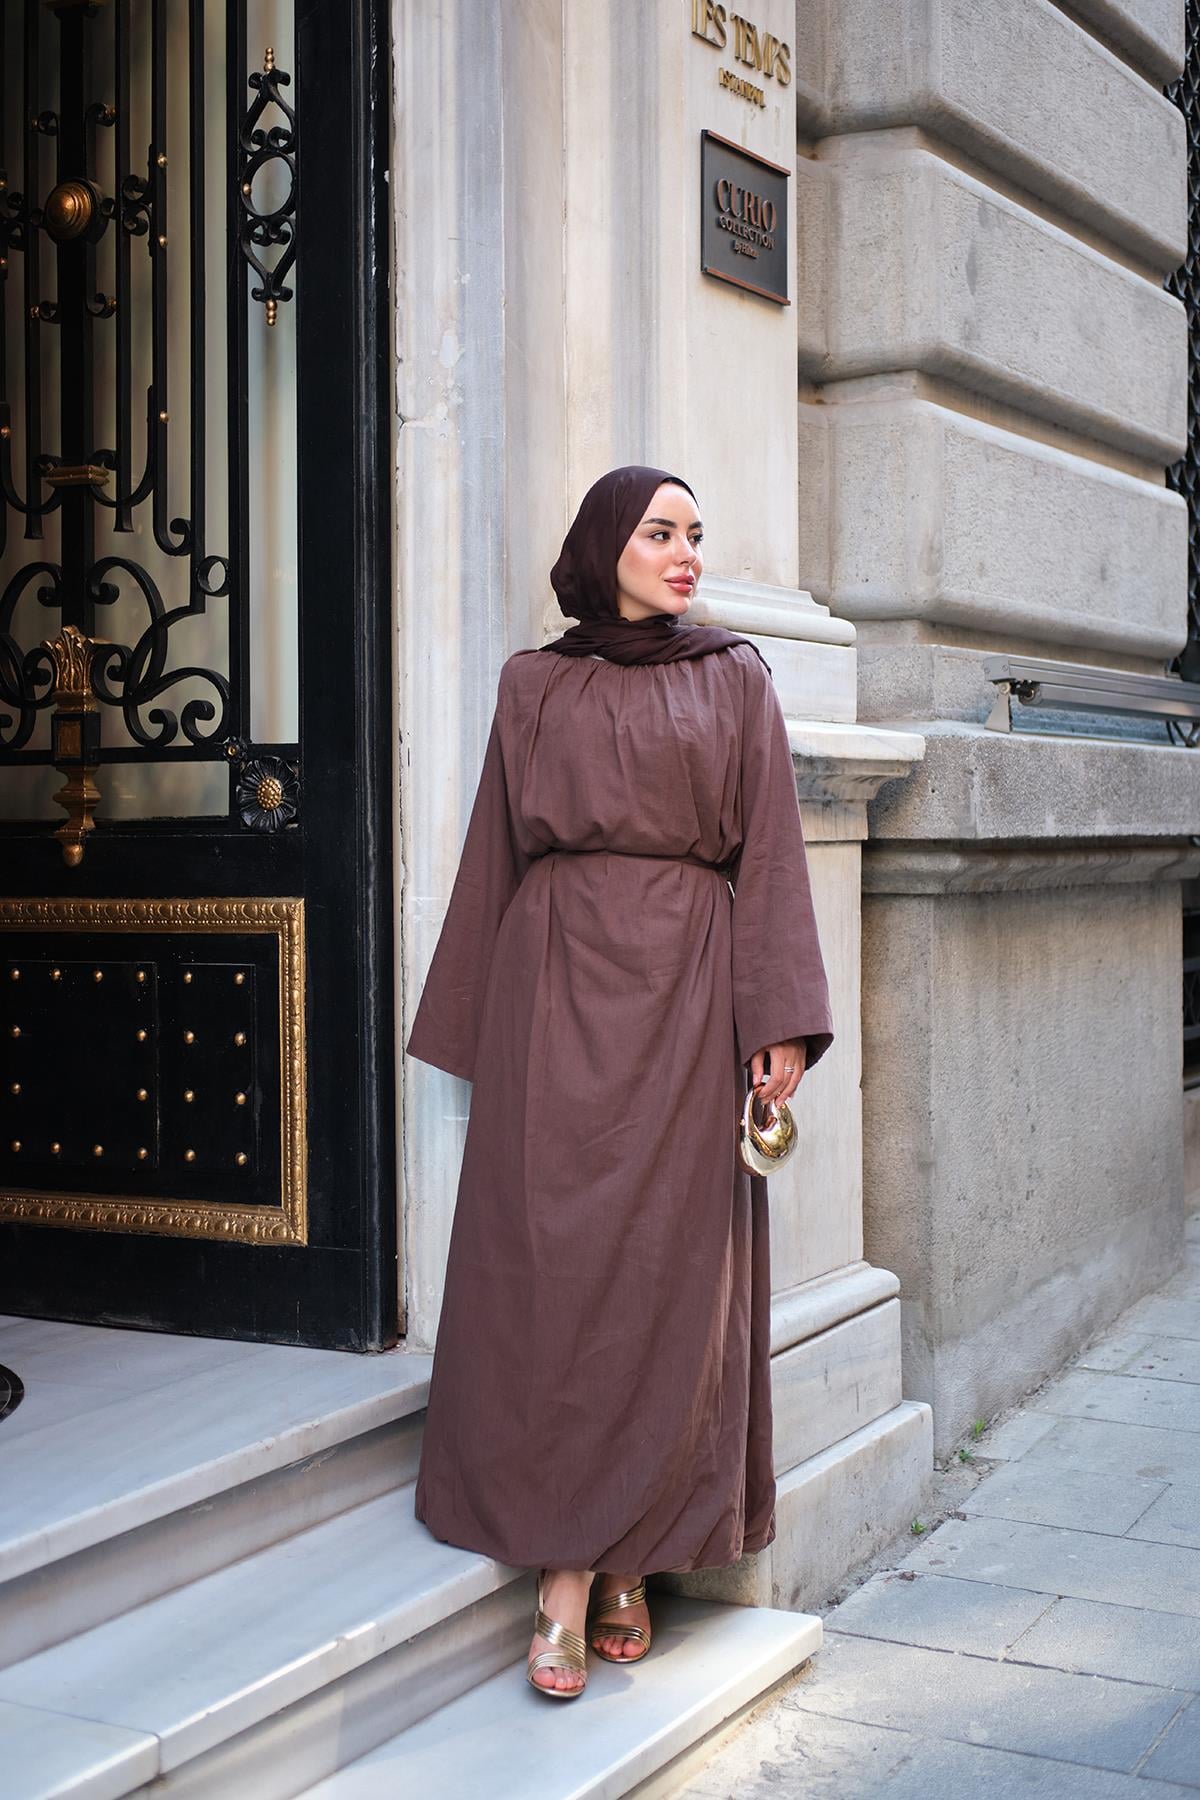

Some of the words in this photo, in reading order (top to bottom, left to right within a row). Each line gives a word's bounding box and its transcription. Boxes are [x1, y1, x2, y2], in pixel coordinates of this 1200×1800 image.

[730, 12, 791, 86] TEMPS
[716, 178, 777, 233] CURIO
[718, 215, 775, 250] COLLECTION
